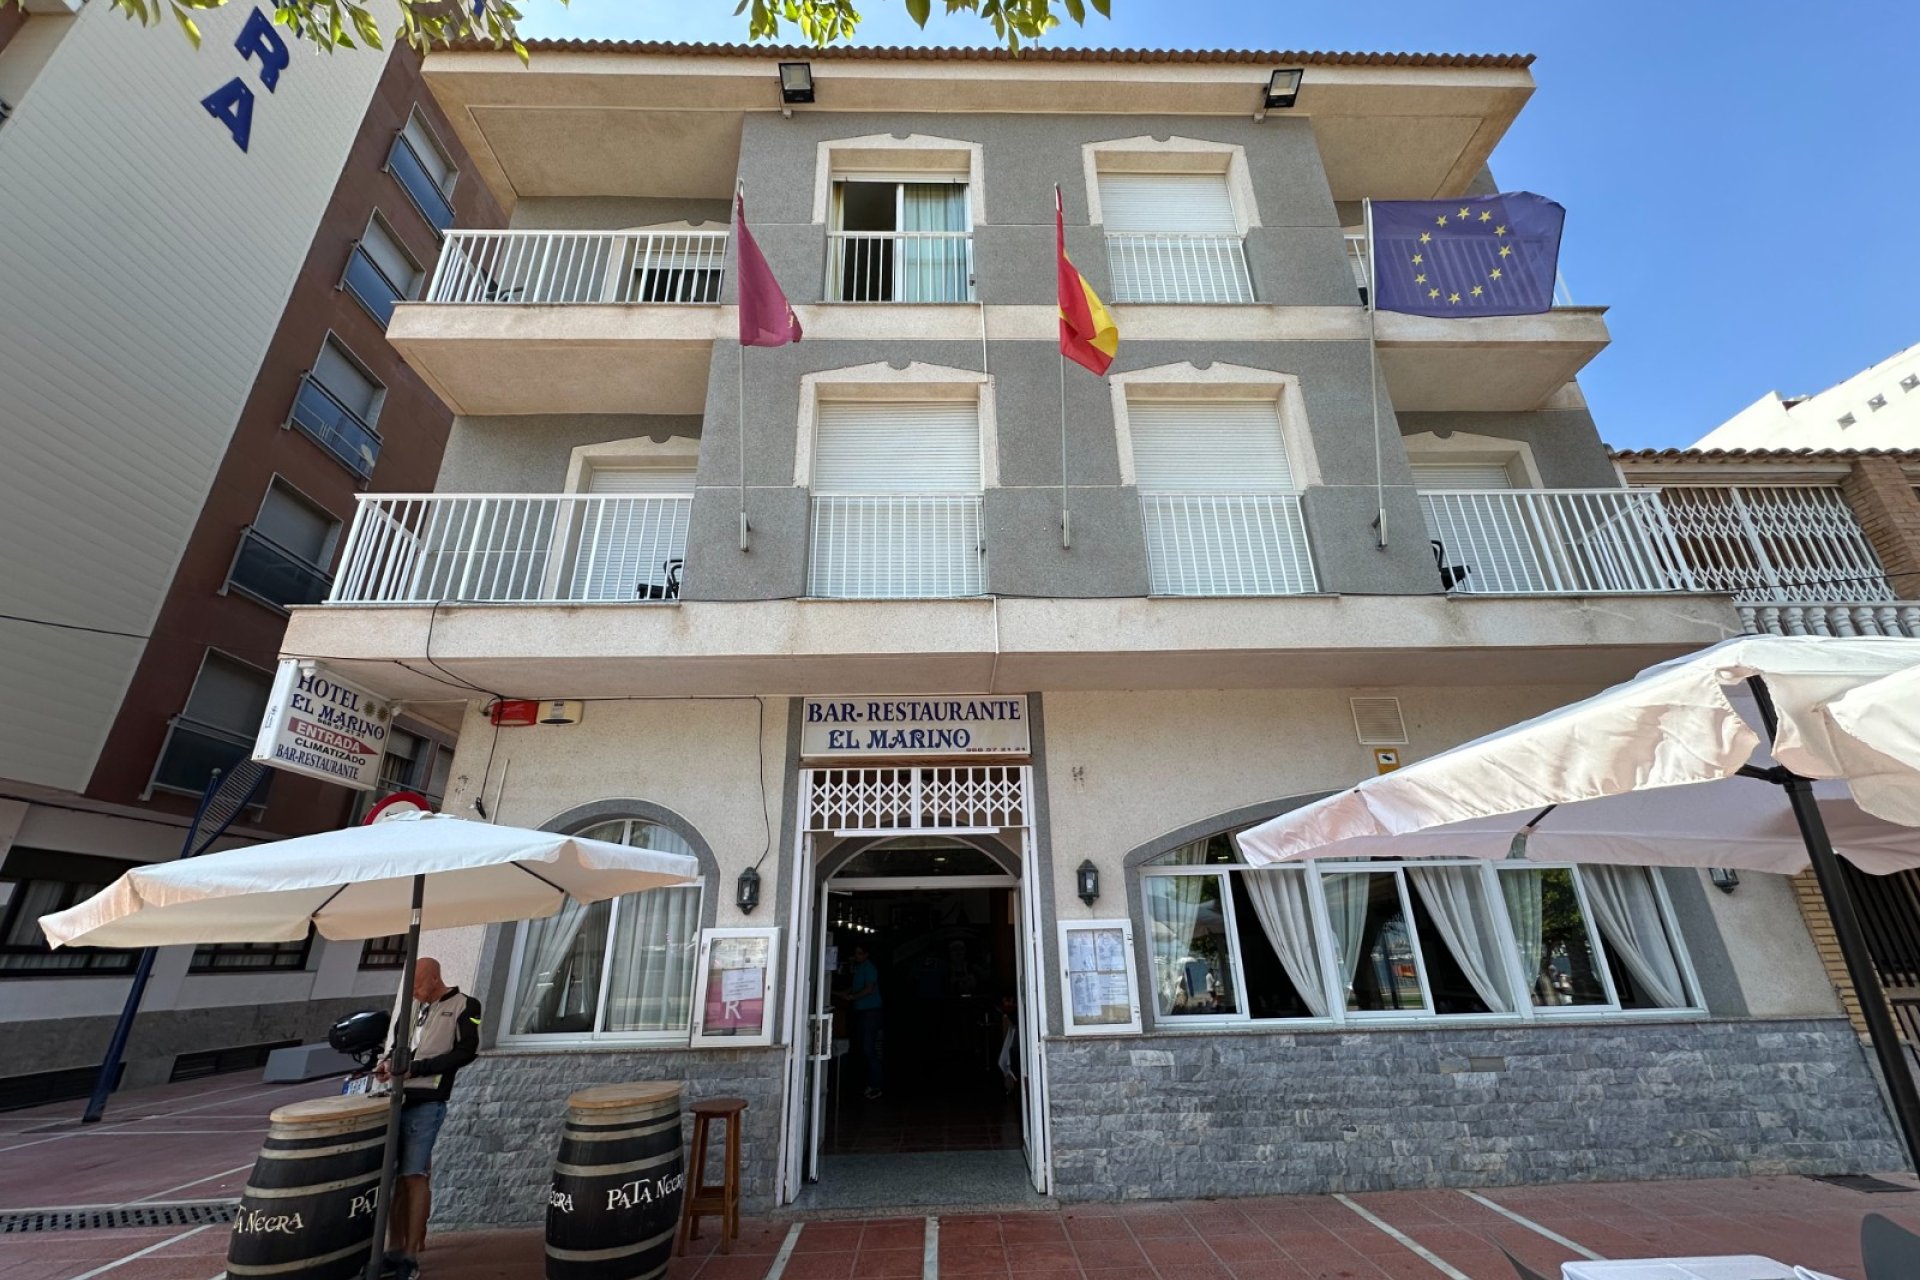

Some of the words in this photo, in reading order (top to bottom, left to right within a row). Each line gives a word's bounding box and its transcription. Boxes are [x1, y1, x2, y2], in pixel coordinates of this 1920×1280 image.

[297, 674, 360, 713] HOTEL
[291, 693, 314, 715] EL
[318, 704, 385, 740] MARINO
[294, 736, 366, 766] CLIMATIZADO
[296, 721, 361, 754] ENTRADA
[828, 729, 860, 749] EL
[867, 728, 970, 749] MARINO
[348, 1186, 381, 1218] PAT
